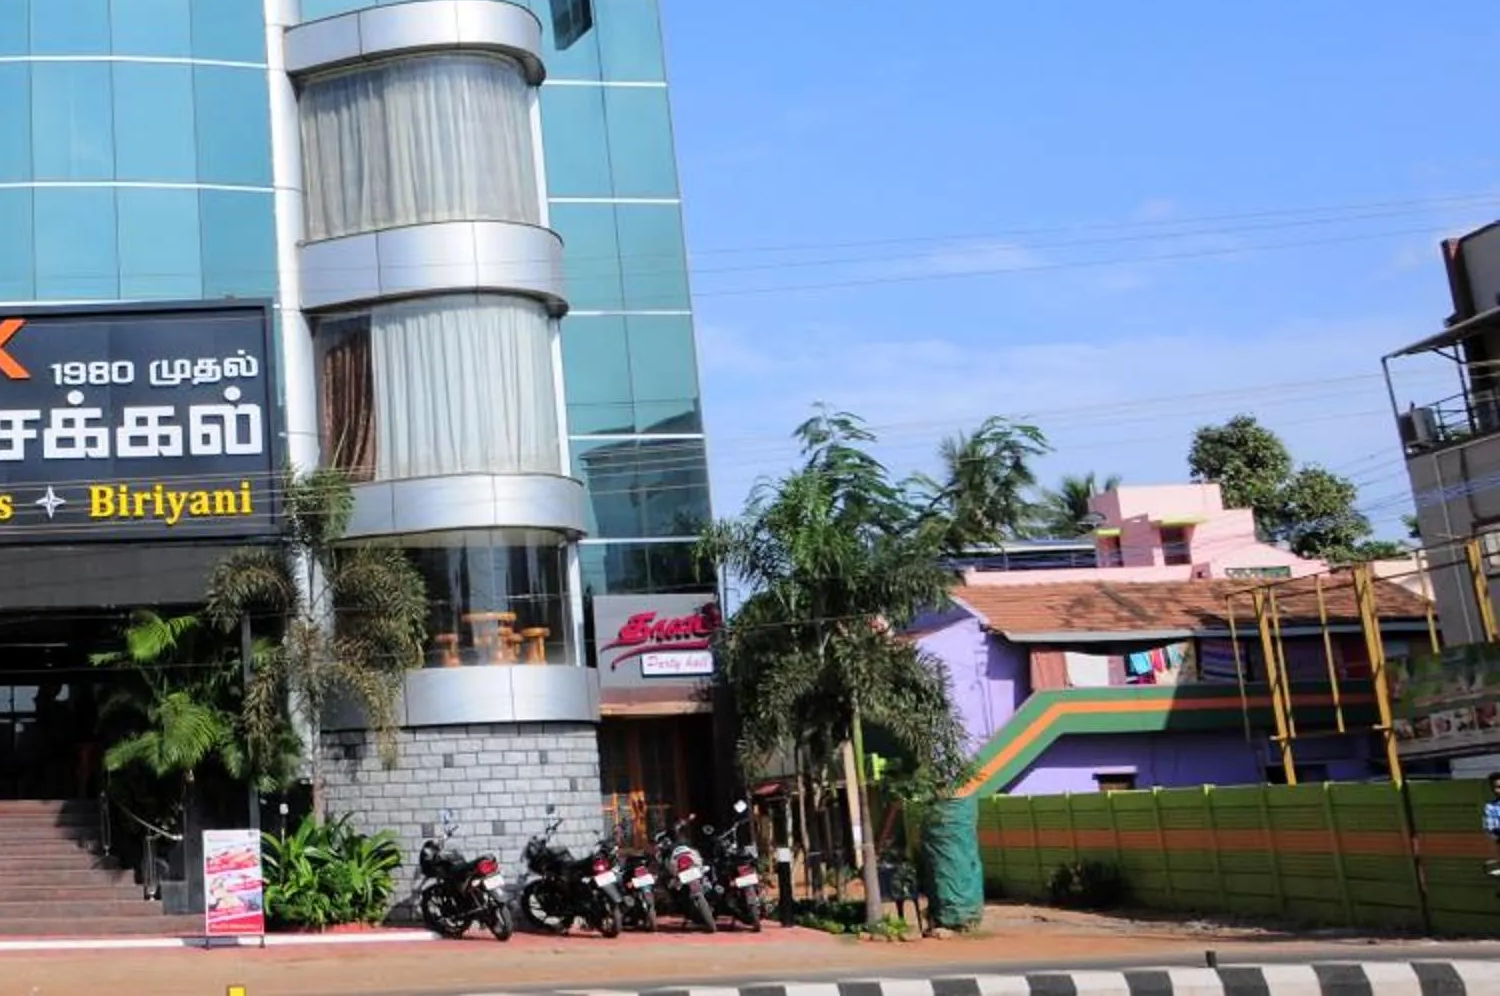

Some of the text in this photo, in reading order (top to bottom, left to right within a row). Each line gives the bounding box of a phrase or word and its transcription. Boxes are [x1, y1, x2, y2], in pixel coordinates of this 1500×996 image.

[51, 350, 259, 386] 1980 முதல்
[88, 480, 254, 525] Biriyani
